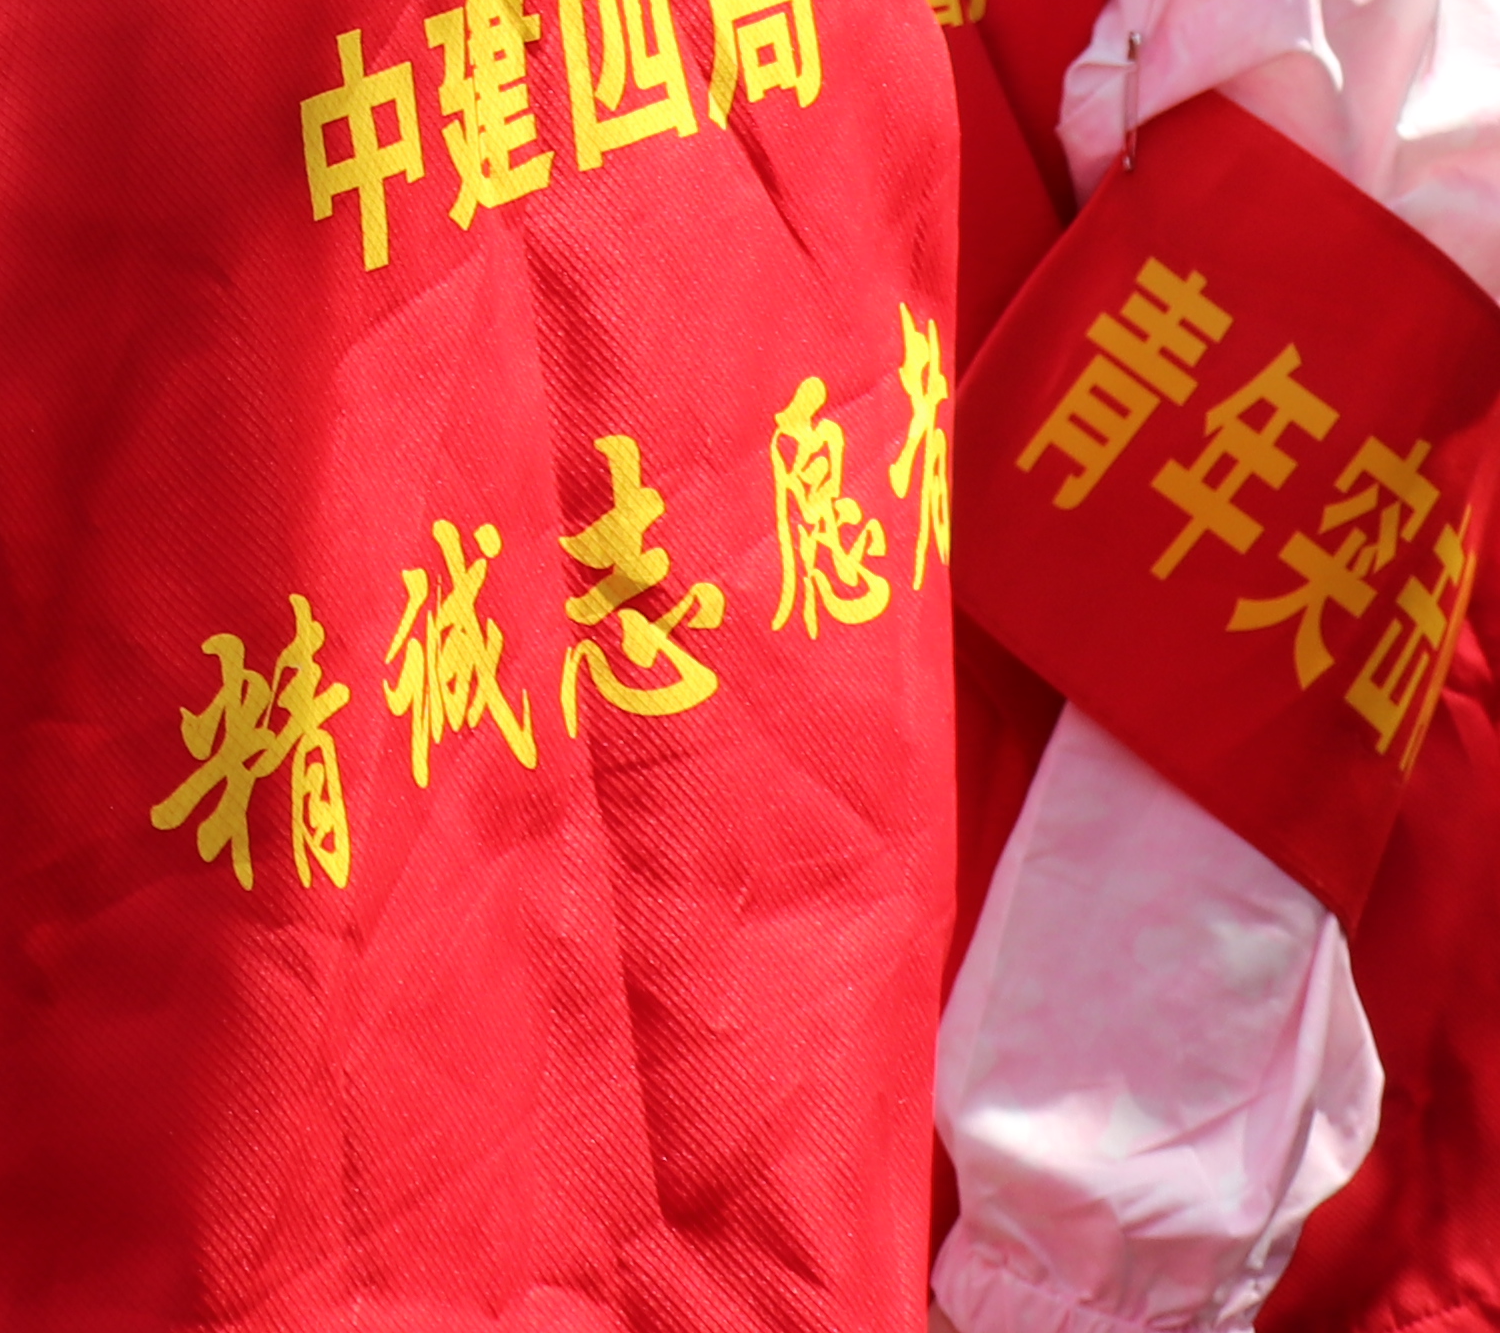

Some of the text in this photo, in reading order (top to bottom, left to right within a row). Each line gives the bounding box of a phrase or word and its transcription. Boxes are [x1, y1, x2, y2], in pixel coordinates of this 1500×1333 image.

[150, 301, 952, 891] 精诚志愿者
[1014, 255, 1478, 785] 青年突击
